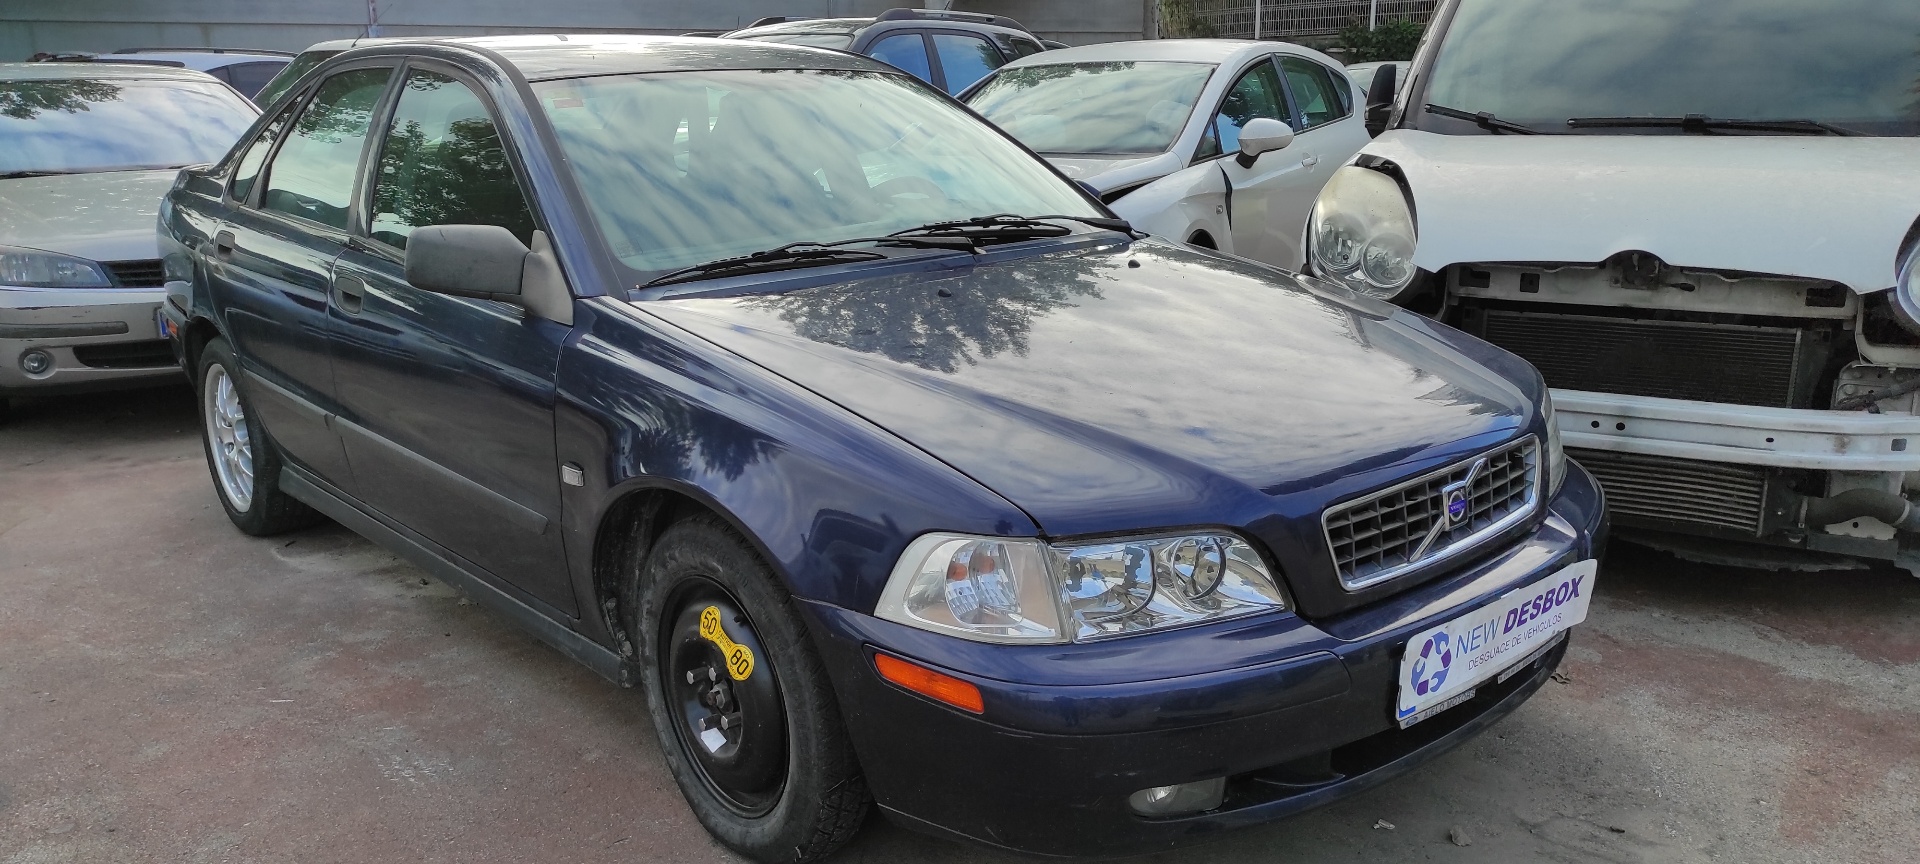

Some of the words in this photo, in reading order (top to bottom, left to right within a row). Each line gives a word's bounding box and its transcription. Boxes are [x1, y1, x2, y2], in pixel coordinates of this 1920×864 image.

[703, 610, 717, 635] 50
[1456, 616, 1501, 658] NEW
[1503, 575, 1585, 635] DESBOX
[731, 649, 749, 675] 80
[1468, 640, 1510, 670] DESGUACE
[1511, 634, 1522, 648] DE
